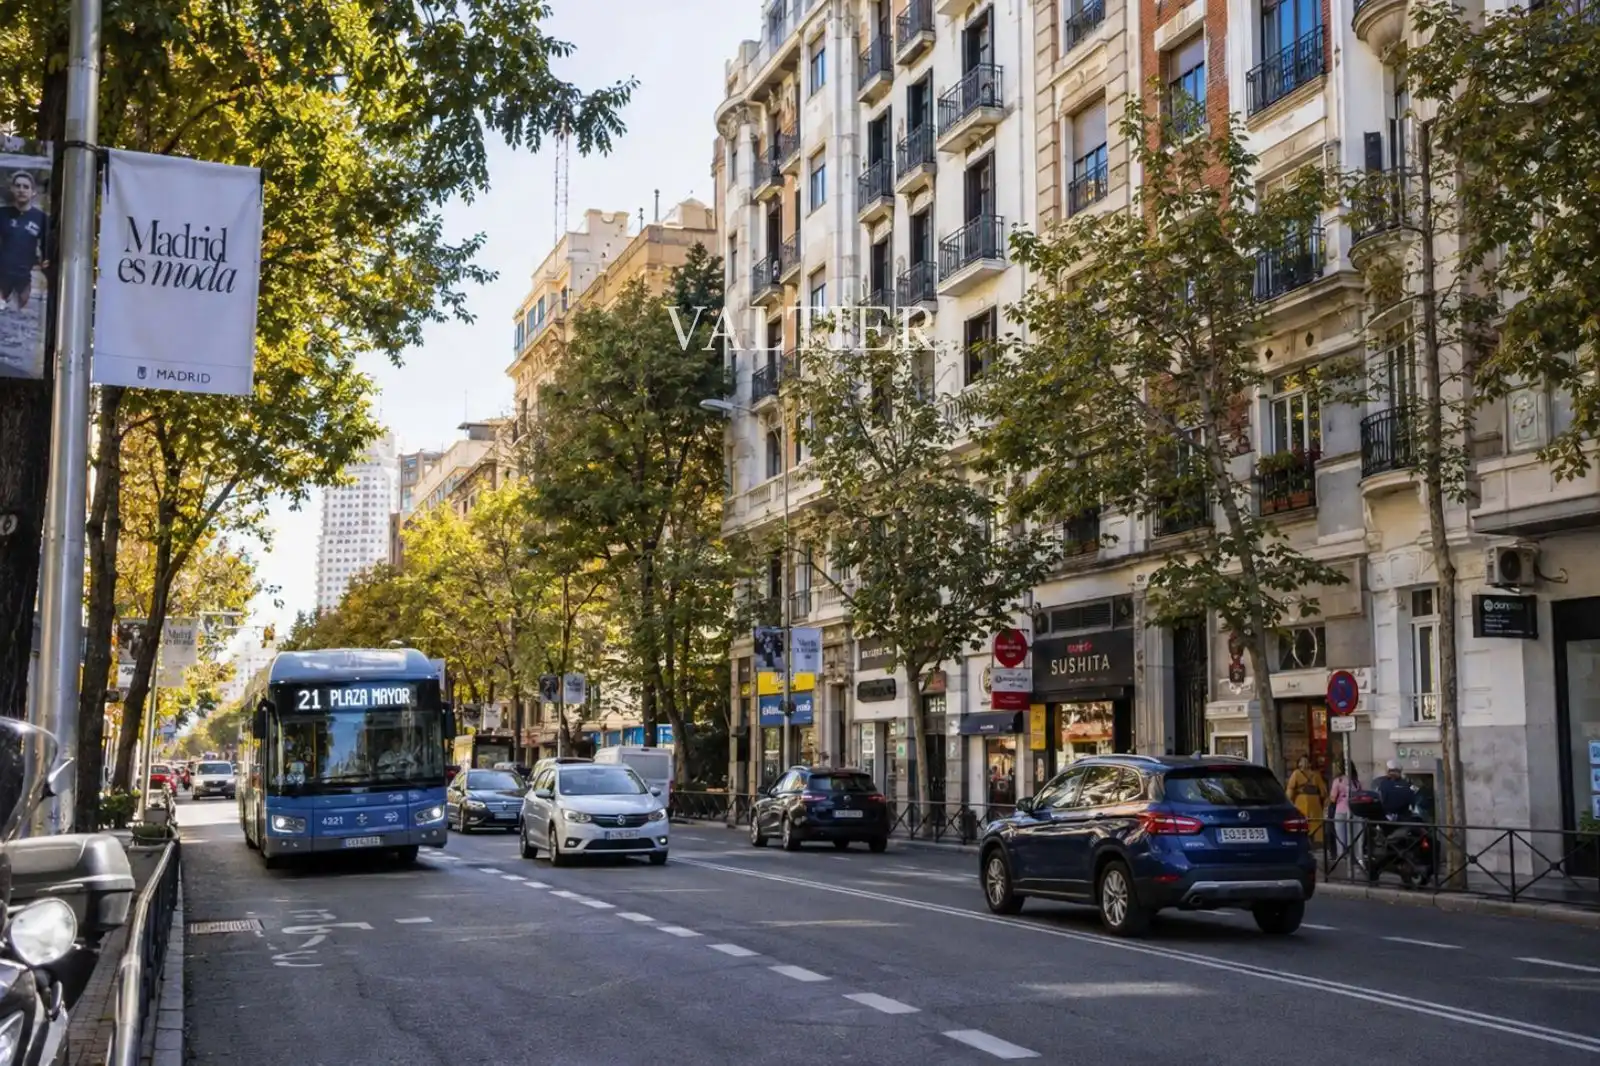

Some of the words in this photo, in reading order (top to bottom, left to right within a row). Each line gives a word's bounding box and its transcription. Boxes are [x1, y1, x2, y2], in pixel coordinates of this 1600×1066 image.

[124, 215, 228, 263] Madrid
[117, 257, 146, 285] es
[151, 259, 238, 294] moda
[156, 369, 211, 384] MADRID
[1051, 653, 1111, 676] SUSHITA
[298, 689, 321, 710] 21
[330, 688, 368, 707] PLAZA
[371, 687, 411, 705] MAYOR
